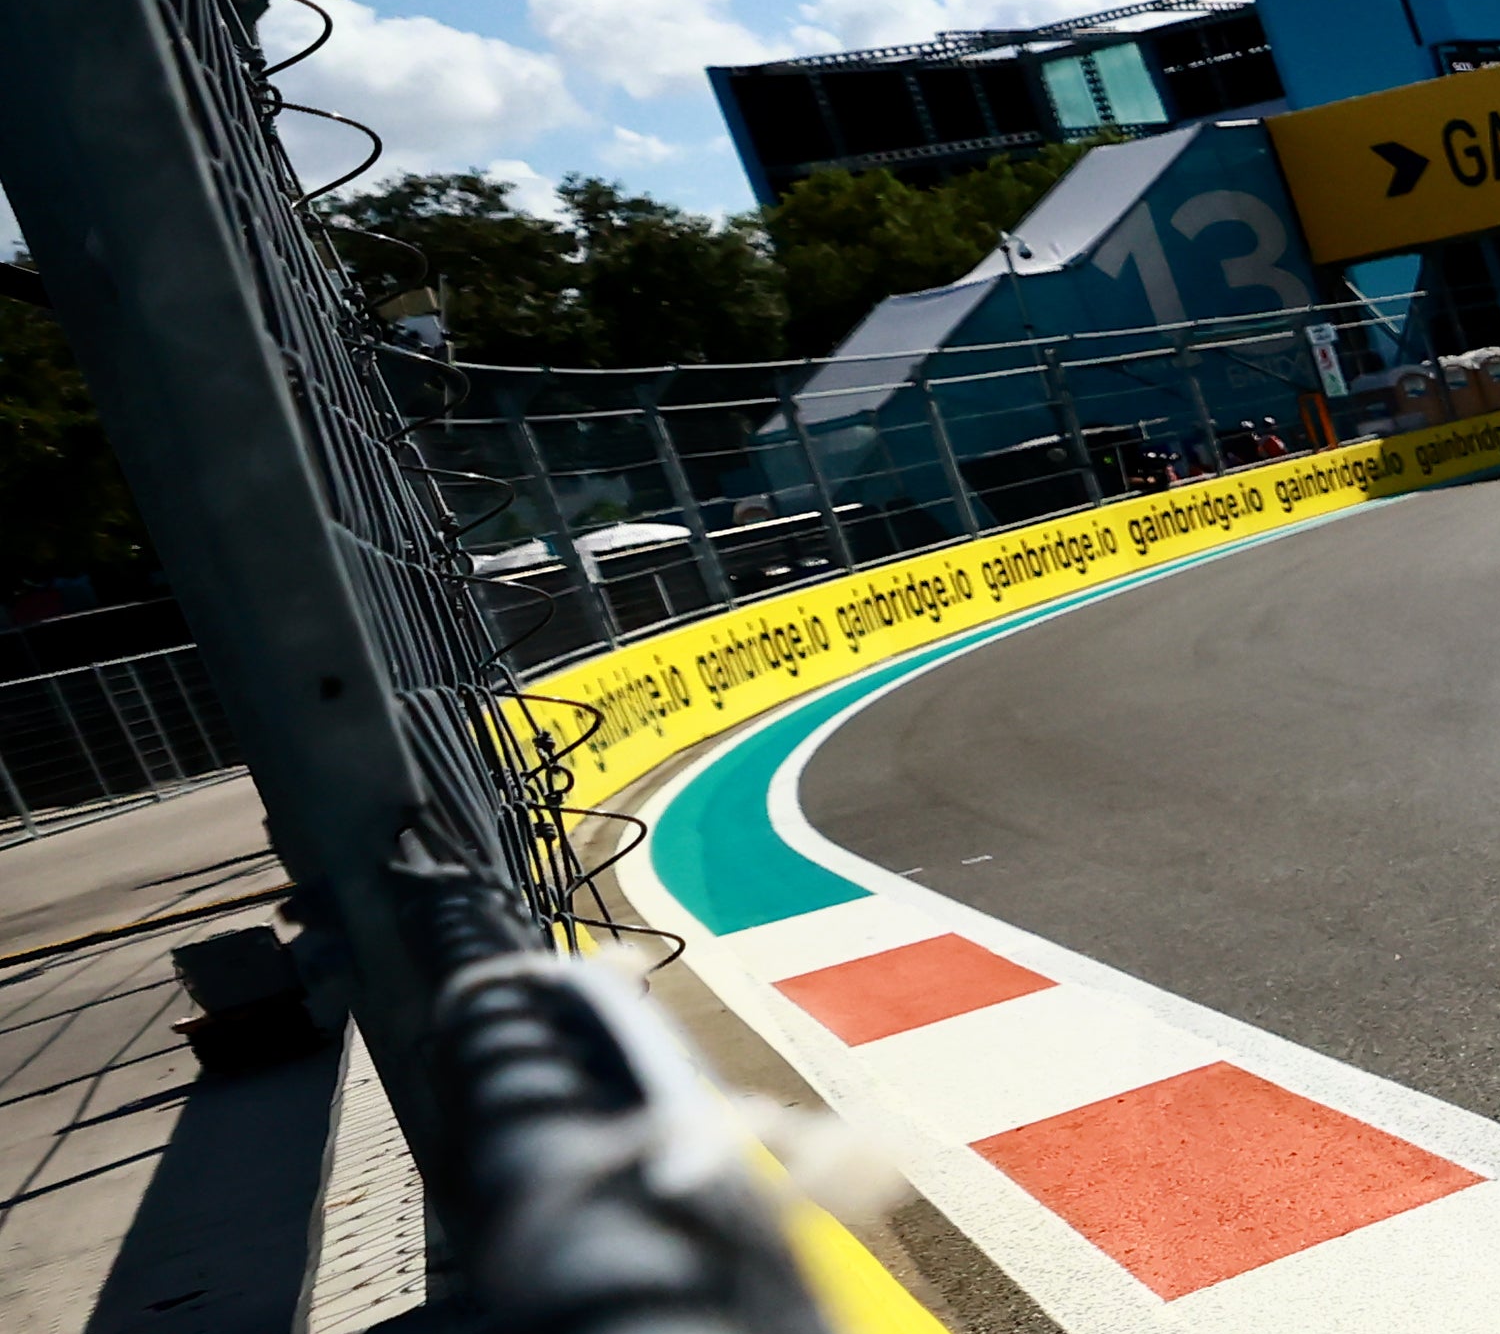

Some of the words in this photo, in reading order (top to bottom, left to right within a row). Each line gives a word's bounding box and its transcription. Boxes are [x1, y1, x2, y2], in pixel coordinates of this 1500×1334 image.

[1092, 189, 1314, 367] 13
[1128, 480, 1264, 555] gainbridge.io
[1275, 443, 1403, 514] gainbridge.io
[980, 521, 1118, 603] gainbridge.io
[835, 561, 972, 652] gainbridge.io
[696, 605, 830, 711] gainbridge.io
